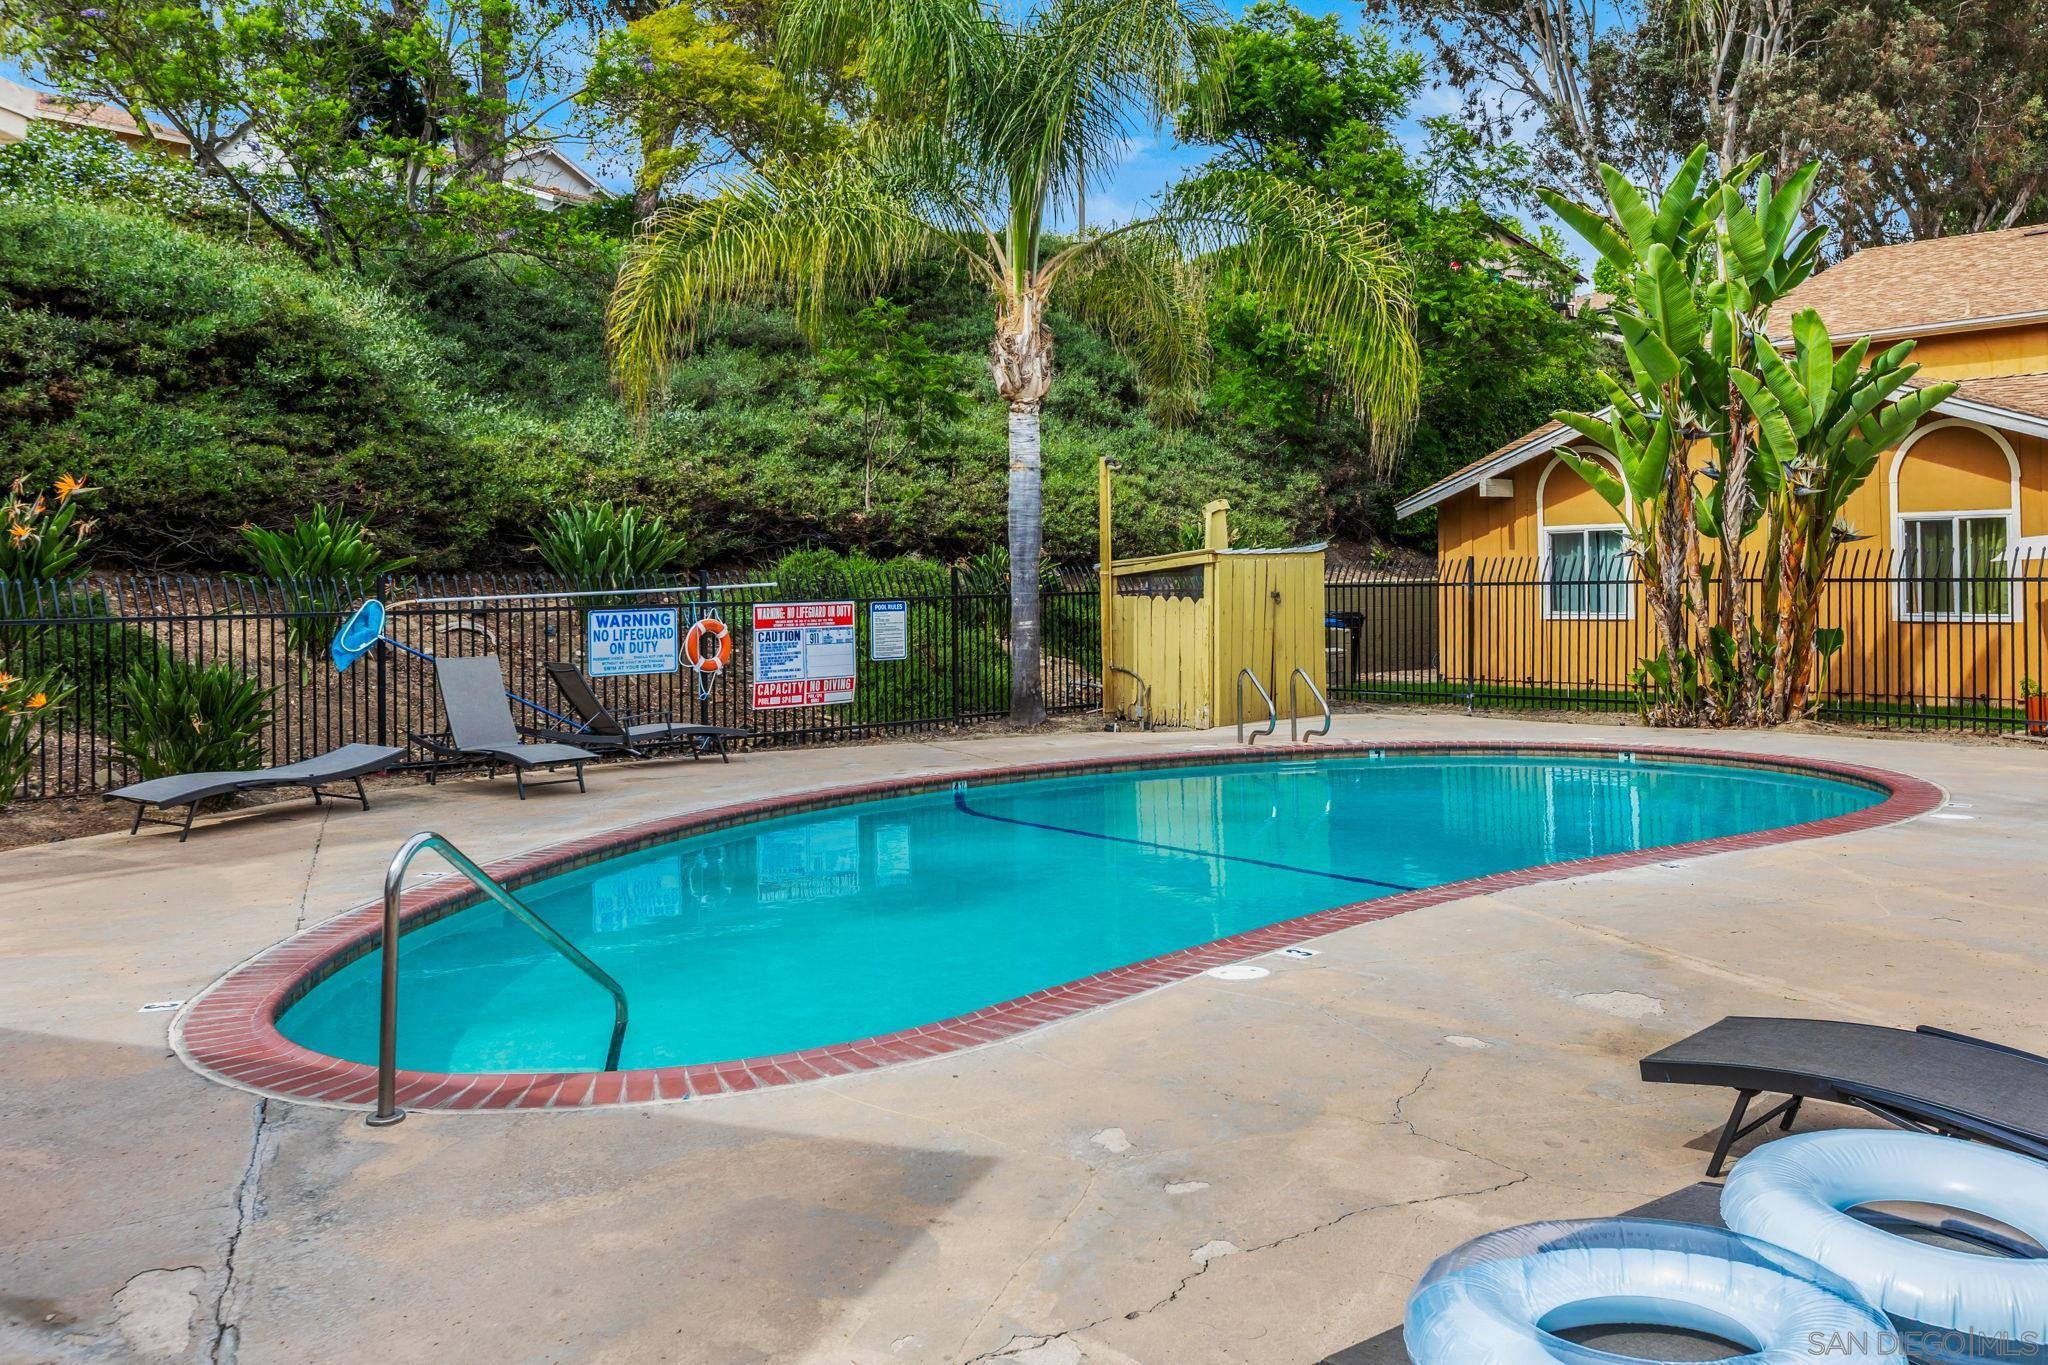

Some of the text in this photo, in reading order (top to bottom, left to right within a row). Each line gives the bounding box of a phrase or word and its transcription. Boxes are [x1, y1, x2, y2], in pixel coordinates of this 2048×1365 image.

[756, 605, 851, 620] WARNING: NO LIFEGUARD ON DUTY
[595, 613, 671, 628] WARNING
[593, 627, 674, 642] NO LIFEGUARD
[758, 630, 801, 643] CAUTION
[809, 633, 820, 644] 911
[609, 641, 658, 654] ON DUTY
[757, 681, 804, 696] CAPACITY
[809, 678, 851, 692] NO DIVING
[757, 696, 792, 705] POOL SPA
